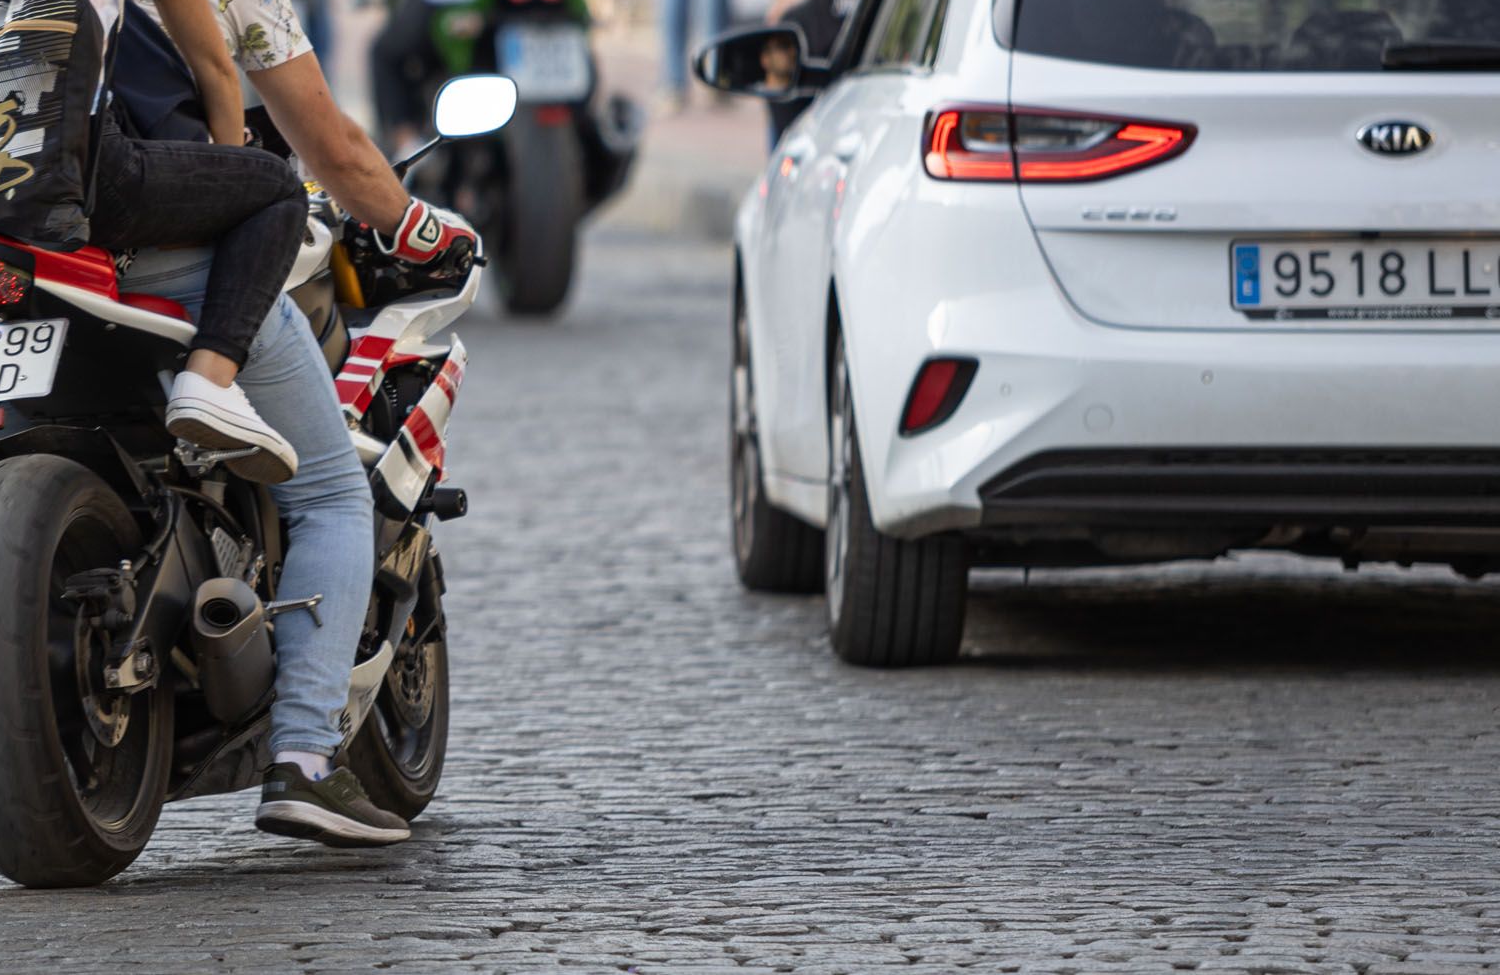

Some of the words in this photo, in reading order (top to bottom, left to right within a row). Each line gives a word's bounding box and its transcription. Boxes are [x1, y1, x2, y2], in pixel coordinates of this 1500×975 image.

[1371, 125, 1422, 152] KIA
[1273, 250, 1407, 297] 9518
[1428, 250, 1500, 297] LL
